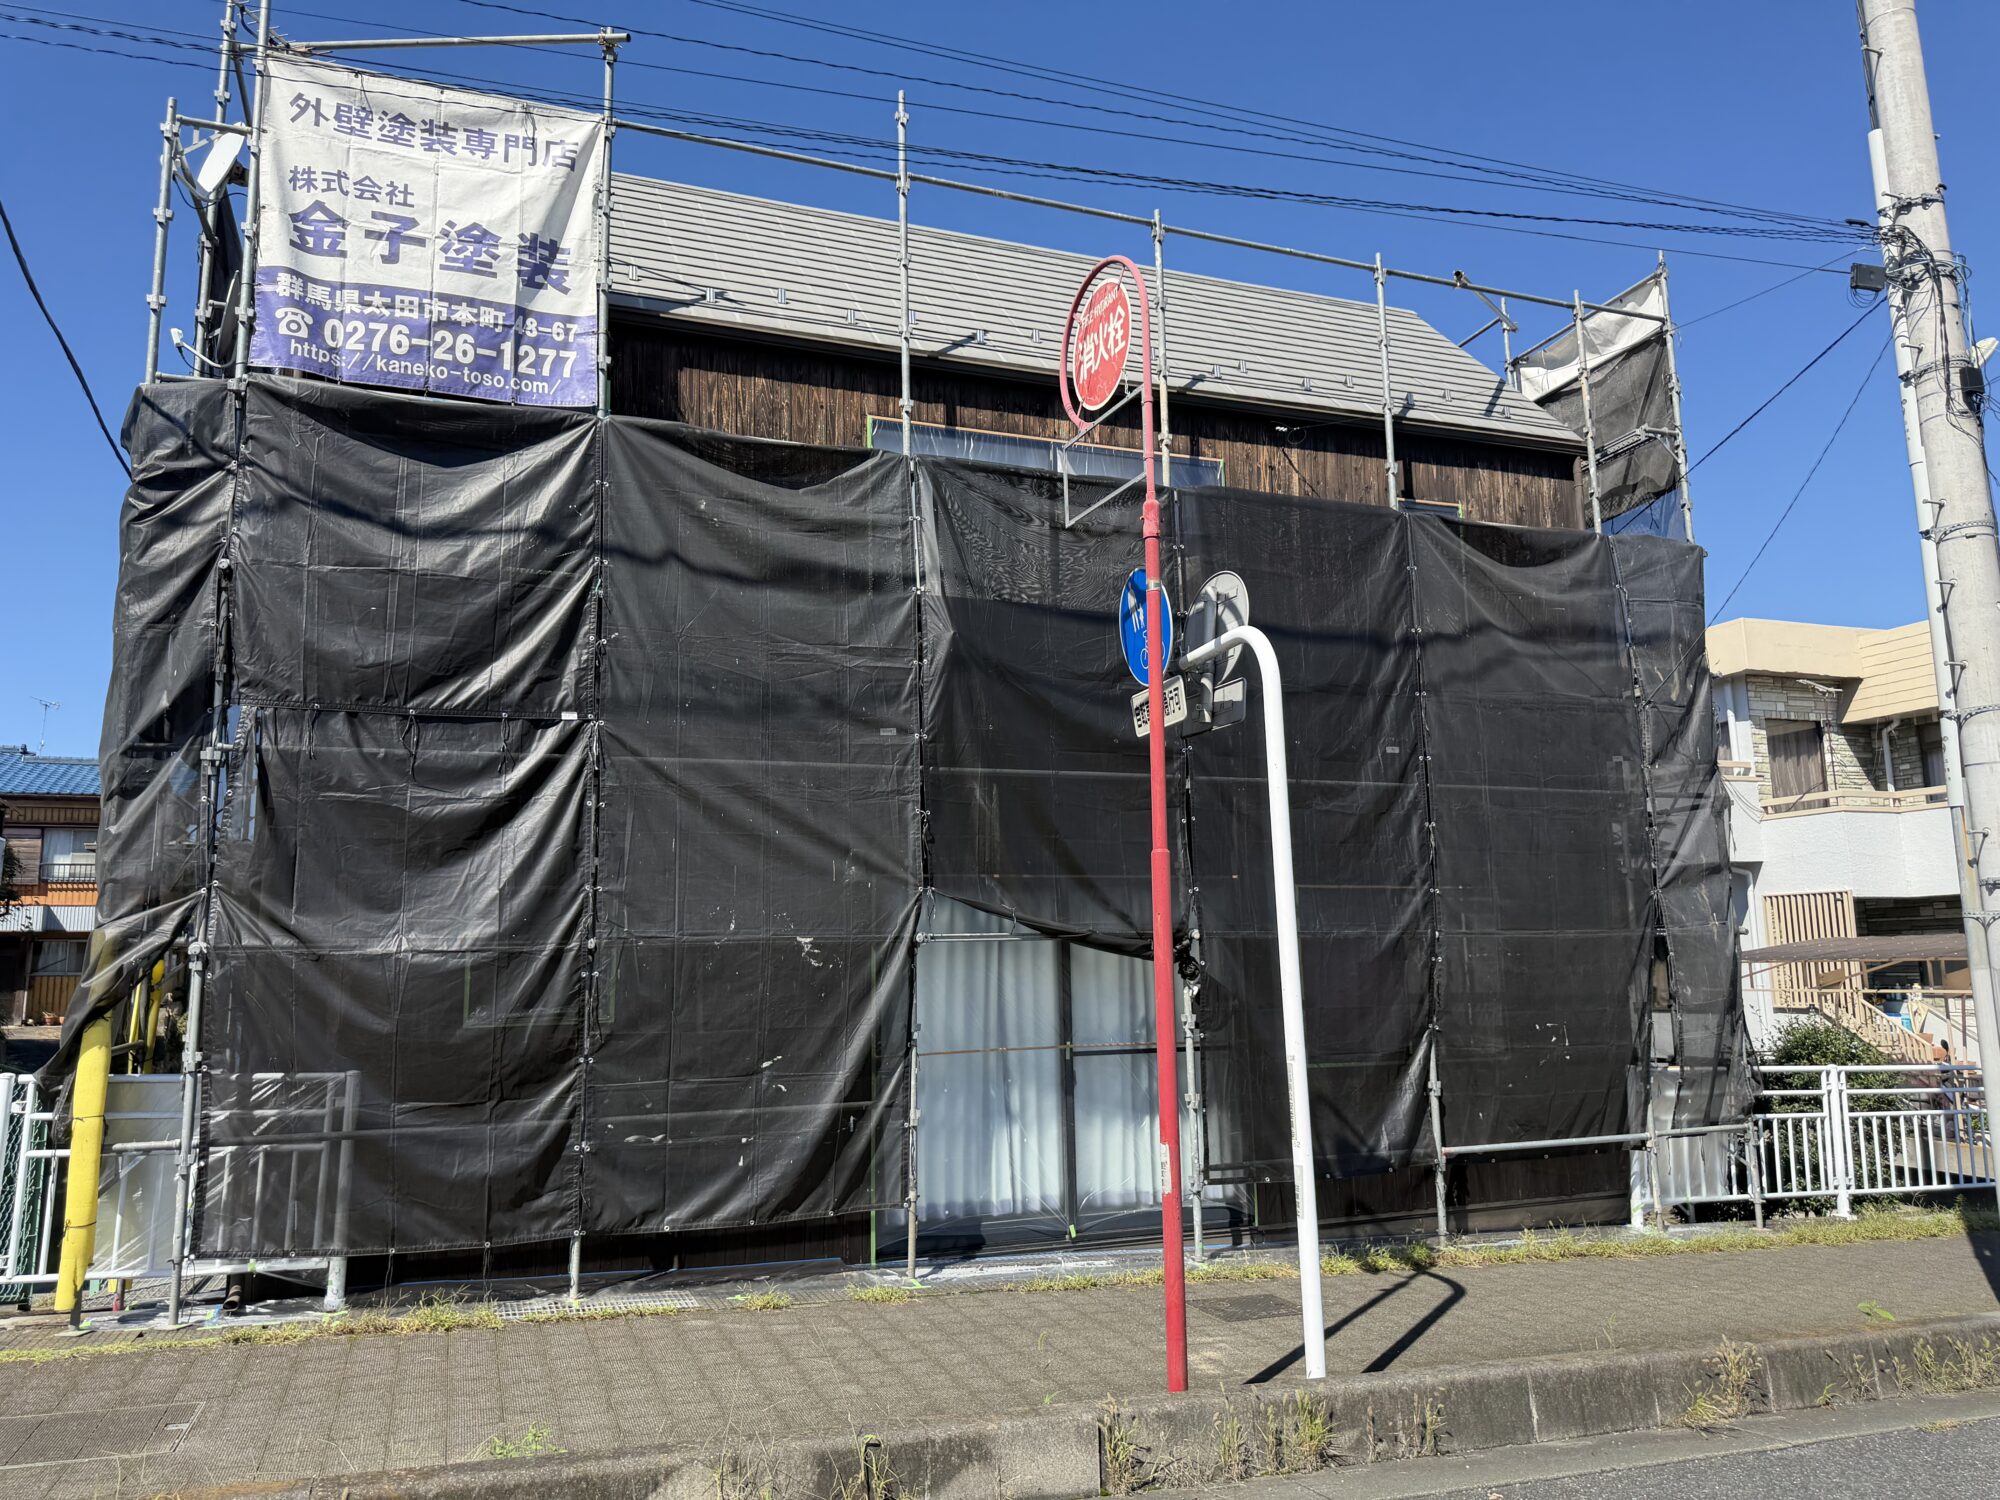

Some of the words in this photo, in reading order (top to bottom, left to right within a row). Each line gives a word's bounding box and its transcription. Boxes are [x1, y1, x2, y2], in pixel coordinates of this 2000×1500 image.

[289, 92, 579, 172] 外壁塗装専門店
[288, 165, 415, 208] 株式会社
[288, 200, 572, 296] 金子塗装
[276, 272, 506, 333] 群馬県太田市本町
[290, 338, 561, 396] https://kaneko-toso.com/
[324, 318, 578, 378] 0276-26-1277
[1078, 304, 1125, 383] 消火栓
